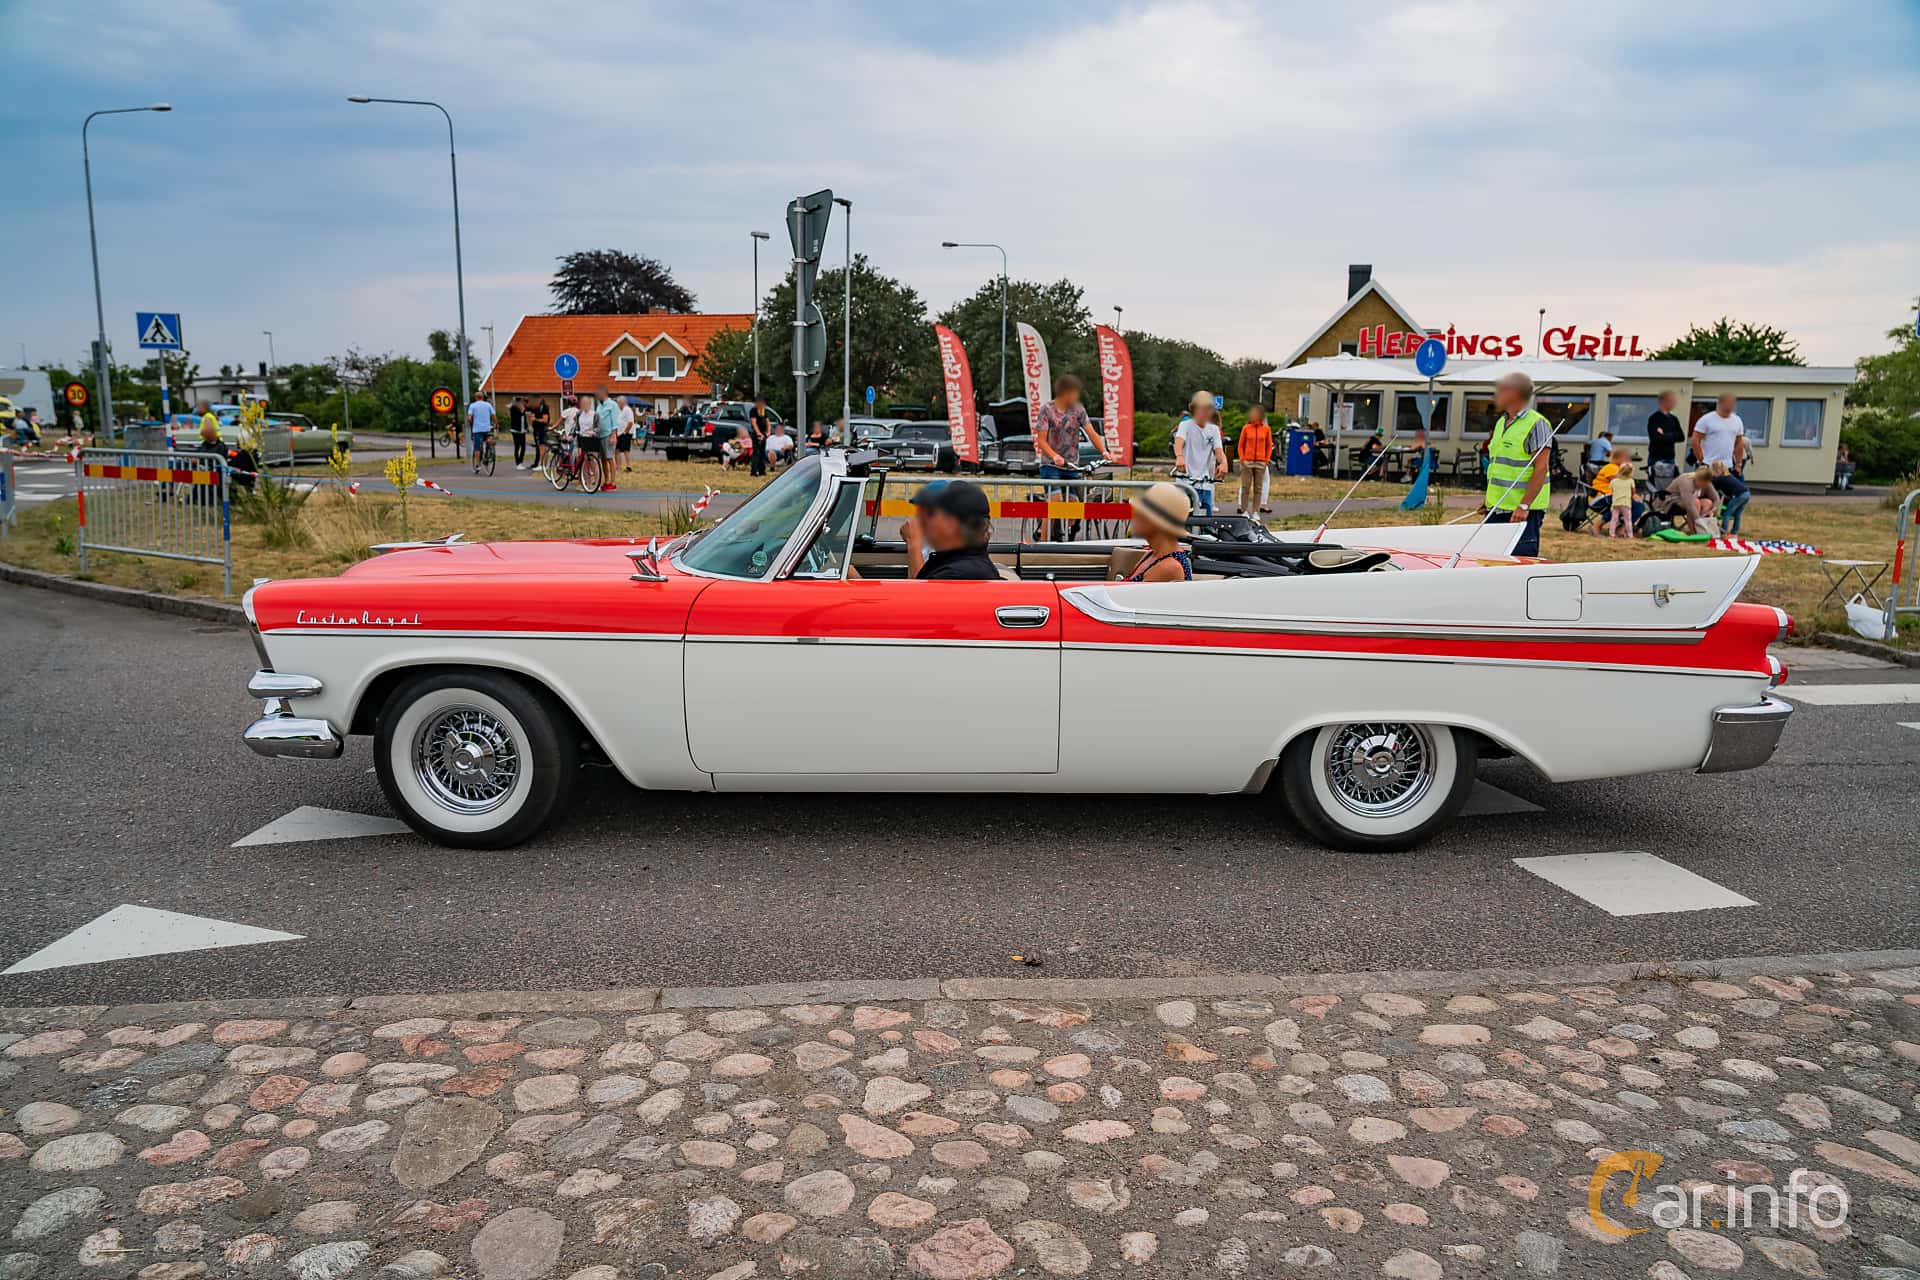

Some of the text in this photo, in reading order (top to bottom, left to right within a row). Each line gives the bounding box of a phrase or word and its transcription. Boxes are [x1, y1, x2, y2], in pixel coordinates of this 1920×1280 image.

[1542, 323, 1644, 360] GRILL
[71, 388, 84, 400] 30
[435, 395, 451, 407] 30
